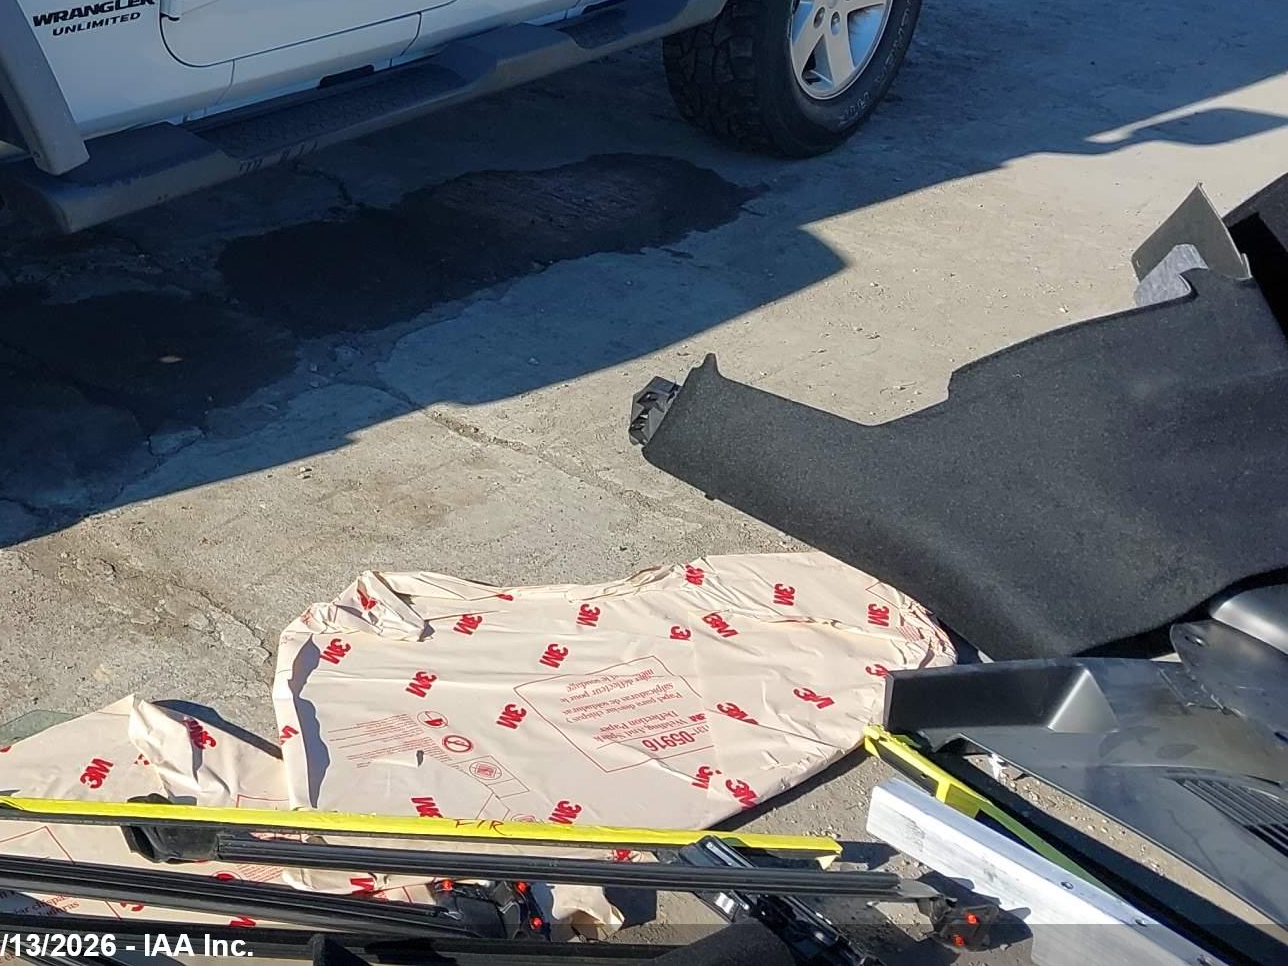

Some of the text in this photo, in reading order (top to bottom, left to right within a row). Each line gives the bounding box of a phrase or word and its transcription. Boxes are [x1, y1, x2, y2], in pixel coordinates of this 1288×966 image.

[52, 12, 141, 36] UNLIMITED
[773, 583, 795, 606] 3M
[576, 603, 601, 627] 3M
[867, 603, 890, 627] 3M
[320, 638, 351, 664] 3M
[539, 643, 569, 669] 3M
[405, 671, 437, 698] 3M
[496, 703, 527, 730] 3M
[599, 710, 678, 732] Deflection Paper
[645, 719, 687, 733] Welding
[623, 728, 645, 739] And
[80, 757, 114, 789] 3M
[725, 779, 758, 810] 3M
[548, 800, 582, 825] 3M
